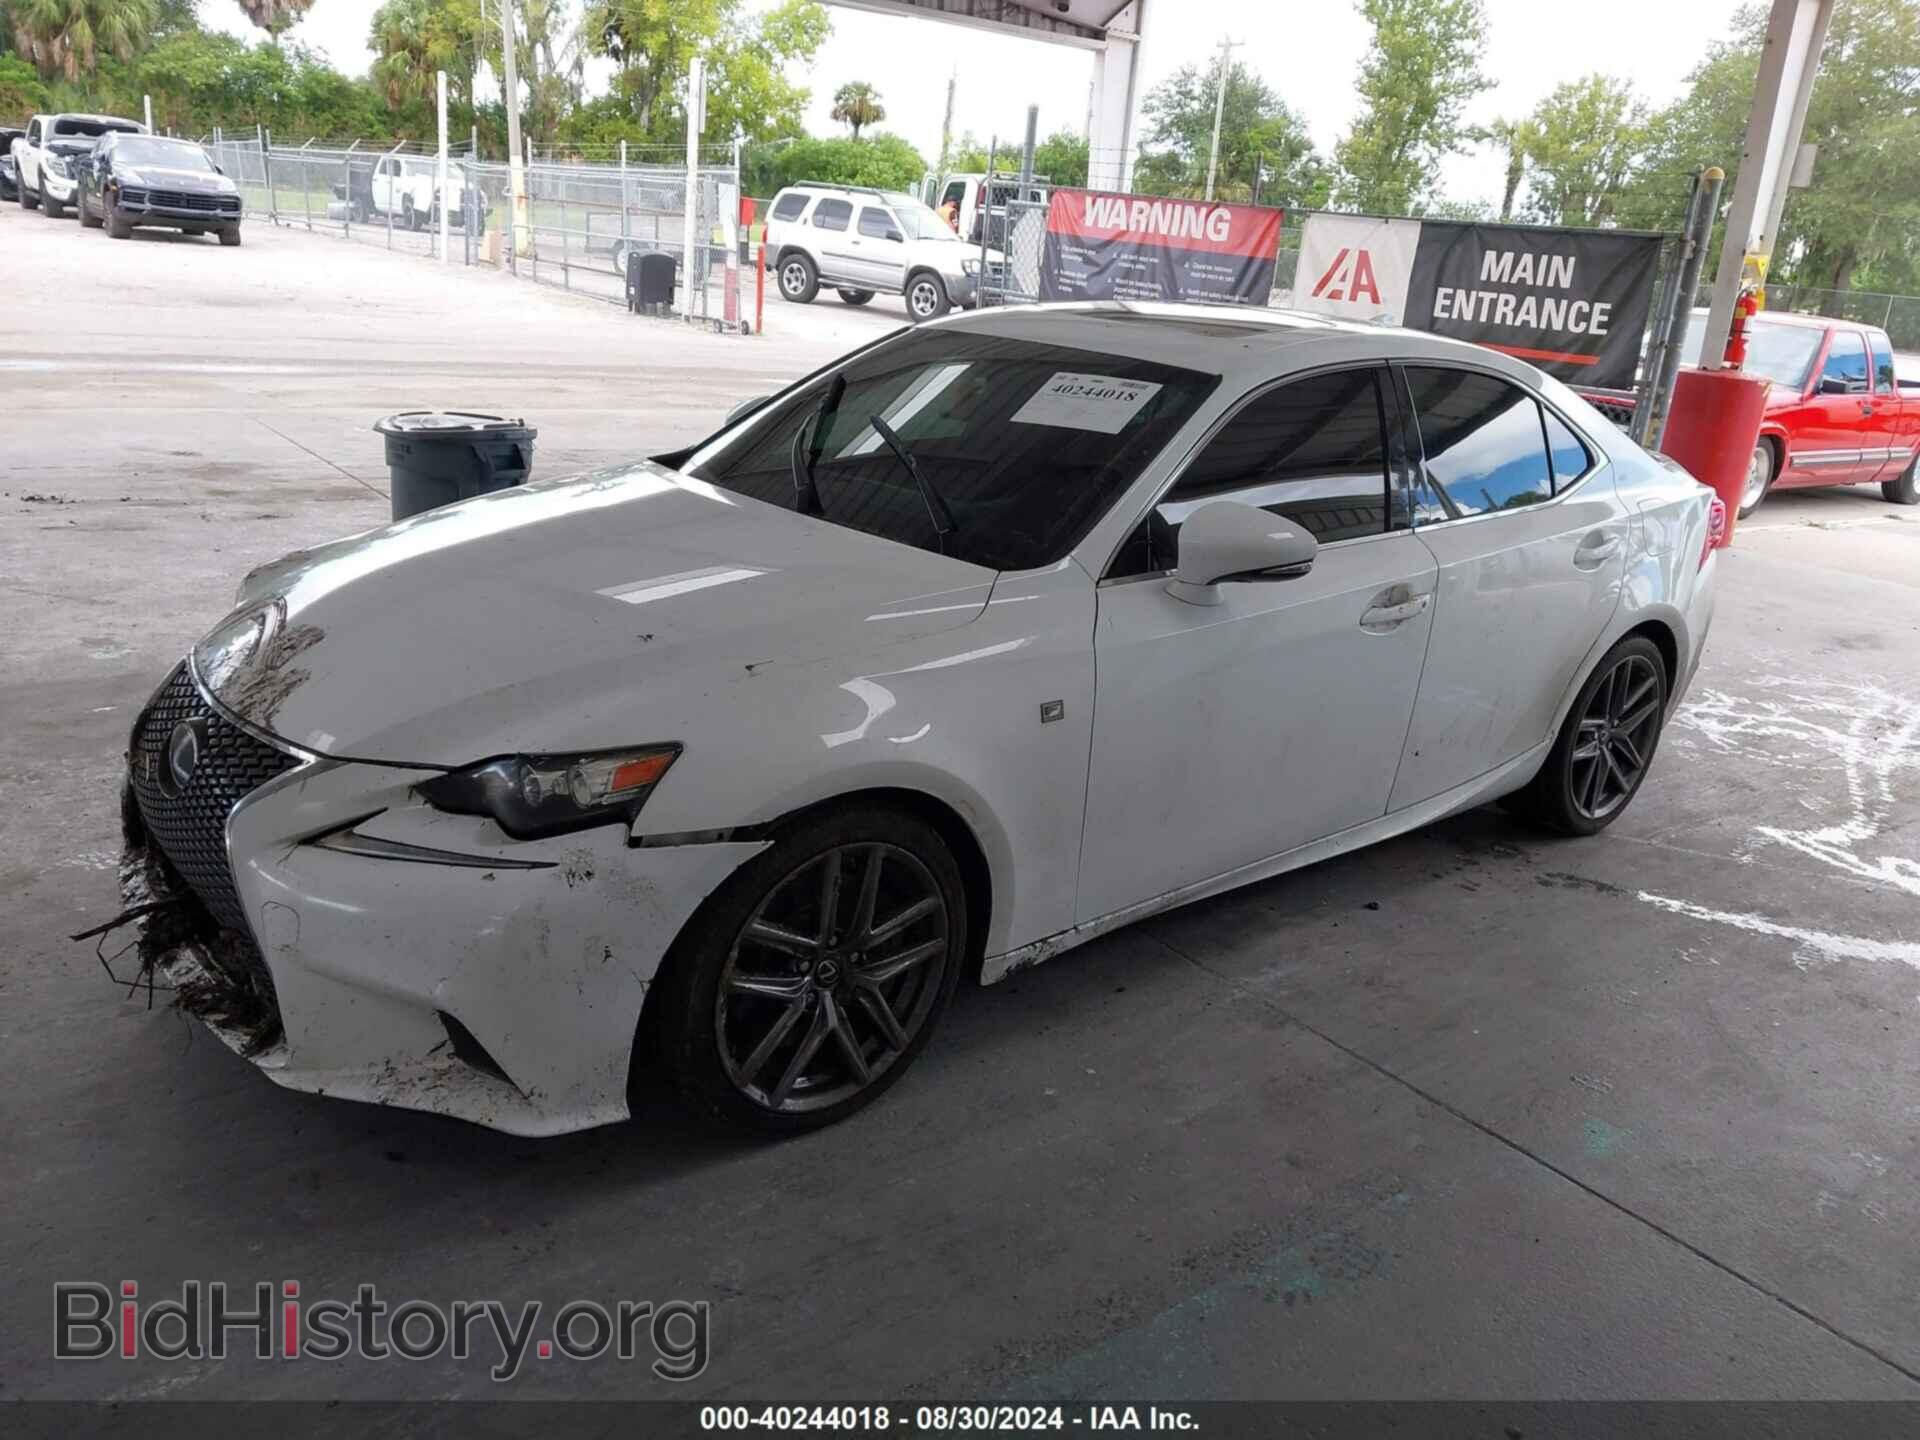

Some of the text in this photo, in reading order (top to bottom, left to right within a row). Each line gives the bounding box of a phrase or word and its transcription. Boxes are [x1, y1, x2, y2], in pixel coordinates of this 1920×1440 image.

[1084, 196, 1231, 242] WARNING
[1480, 250, 1576, 289] MAIN
[1433, 287, 1612, 336] ENTRANCE
[1051, 383, 1139, 402] 40244018
